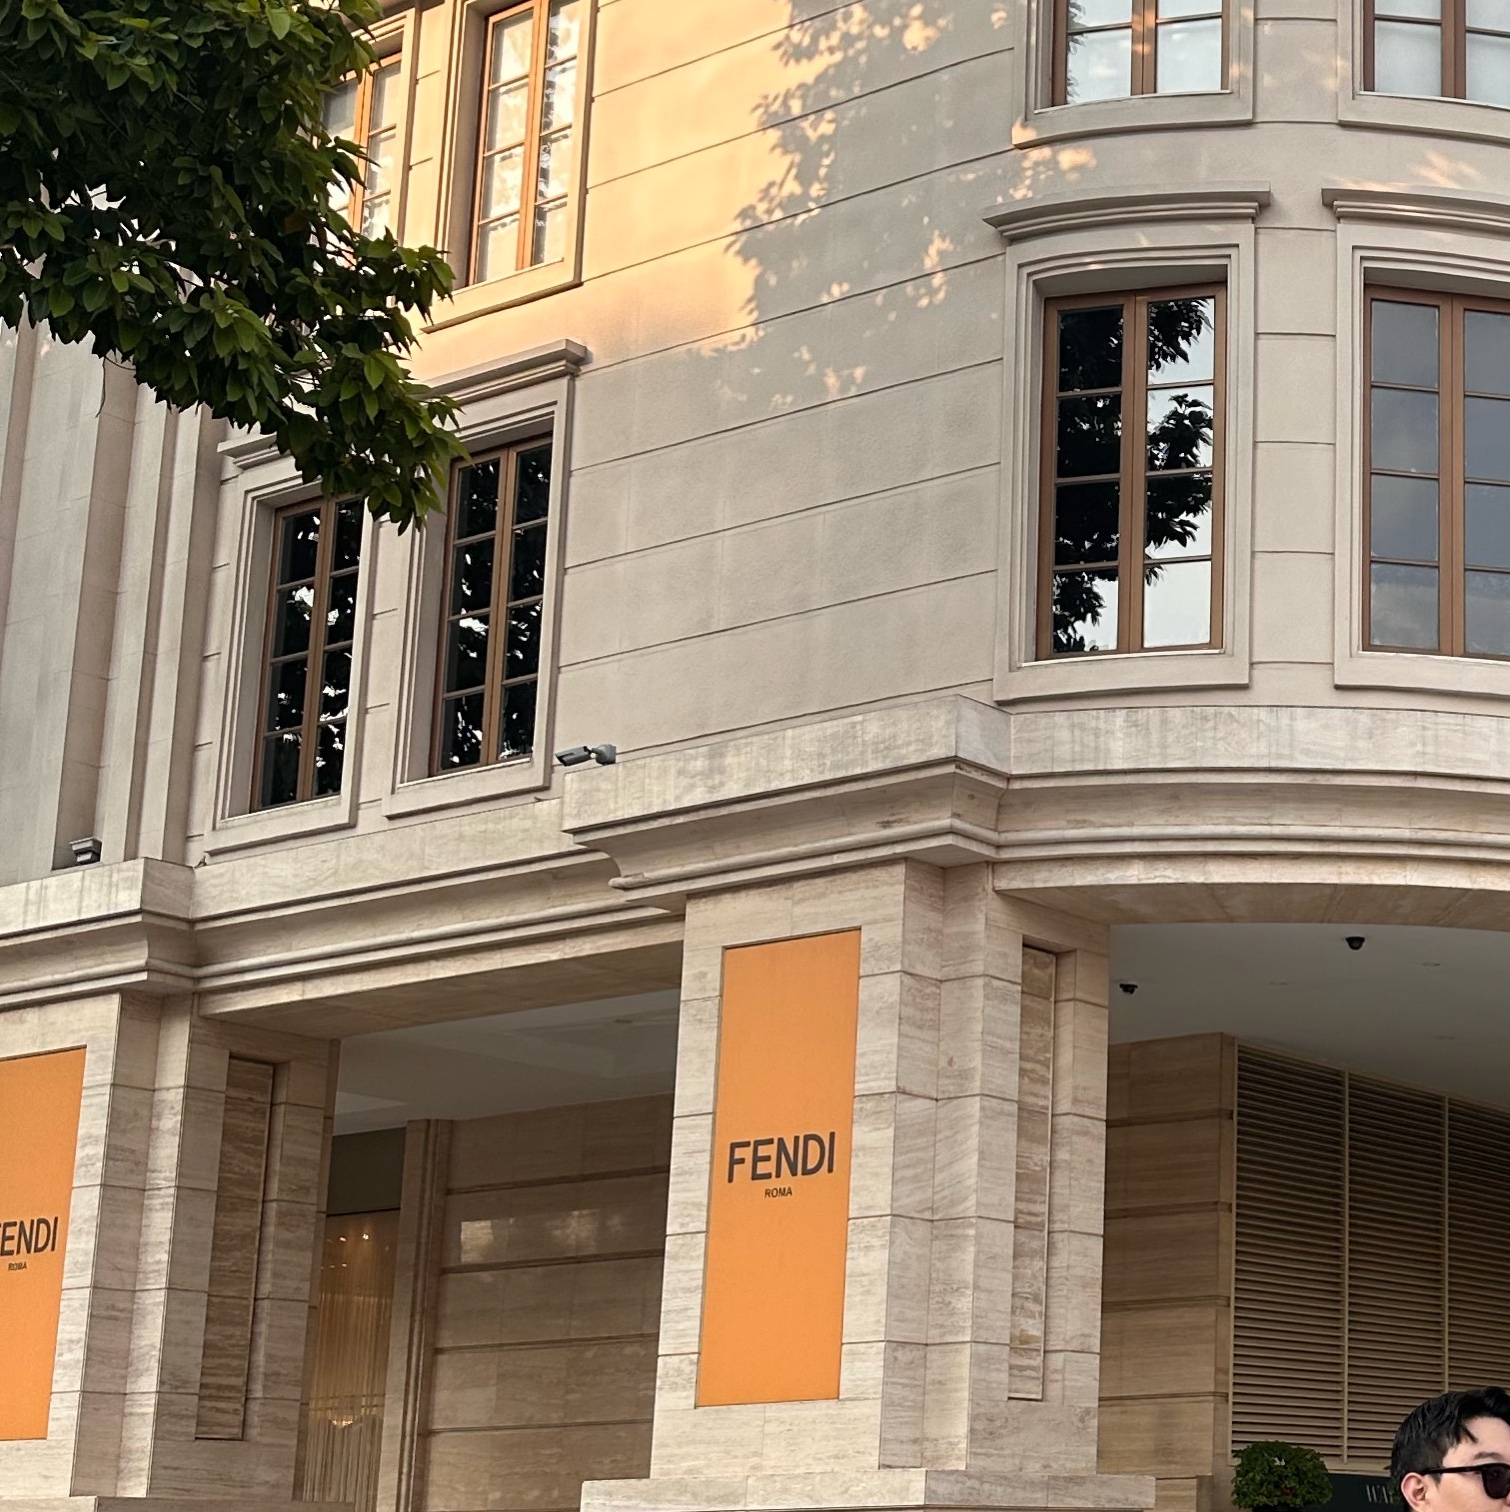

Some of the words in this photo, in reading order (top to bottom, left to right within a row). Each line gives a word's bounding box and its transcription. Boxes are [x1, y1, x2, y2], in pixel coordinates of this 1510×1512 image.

[727, 1131, 836, 1184] FENDI
[764, 1186, 793, 1198] ROMA
[0, 1216, 58, 1257] ENDI
